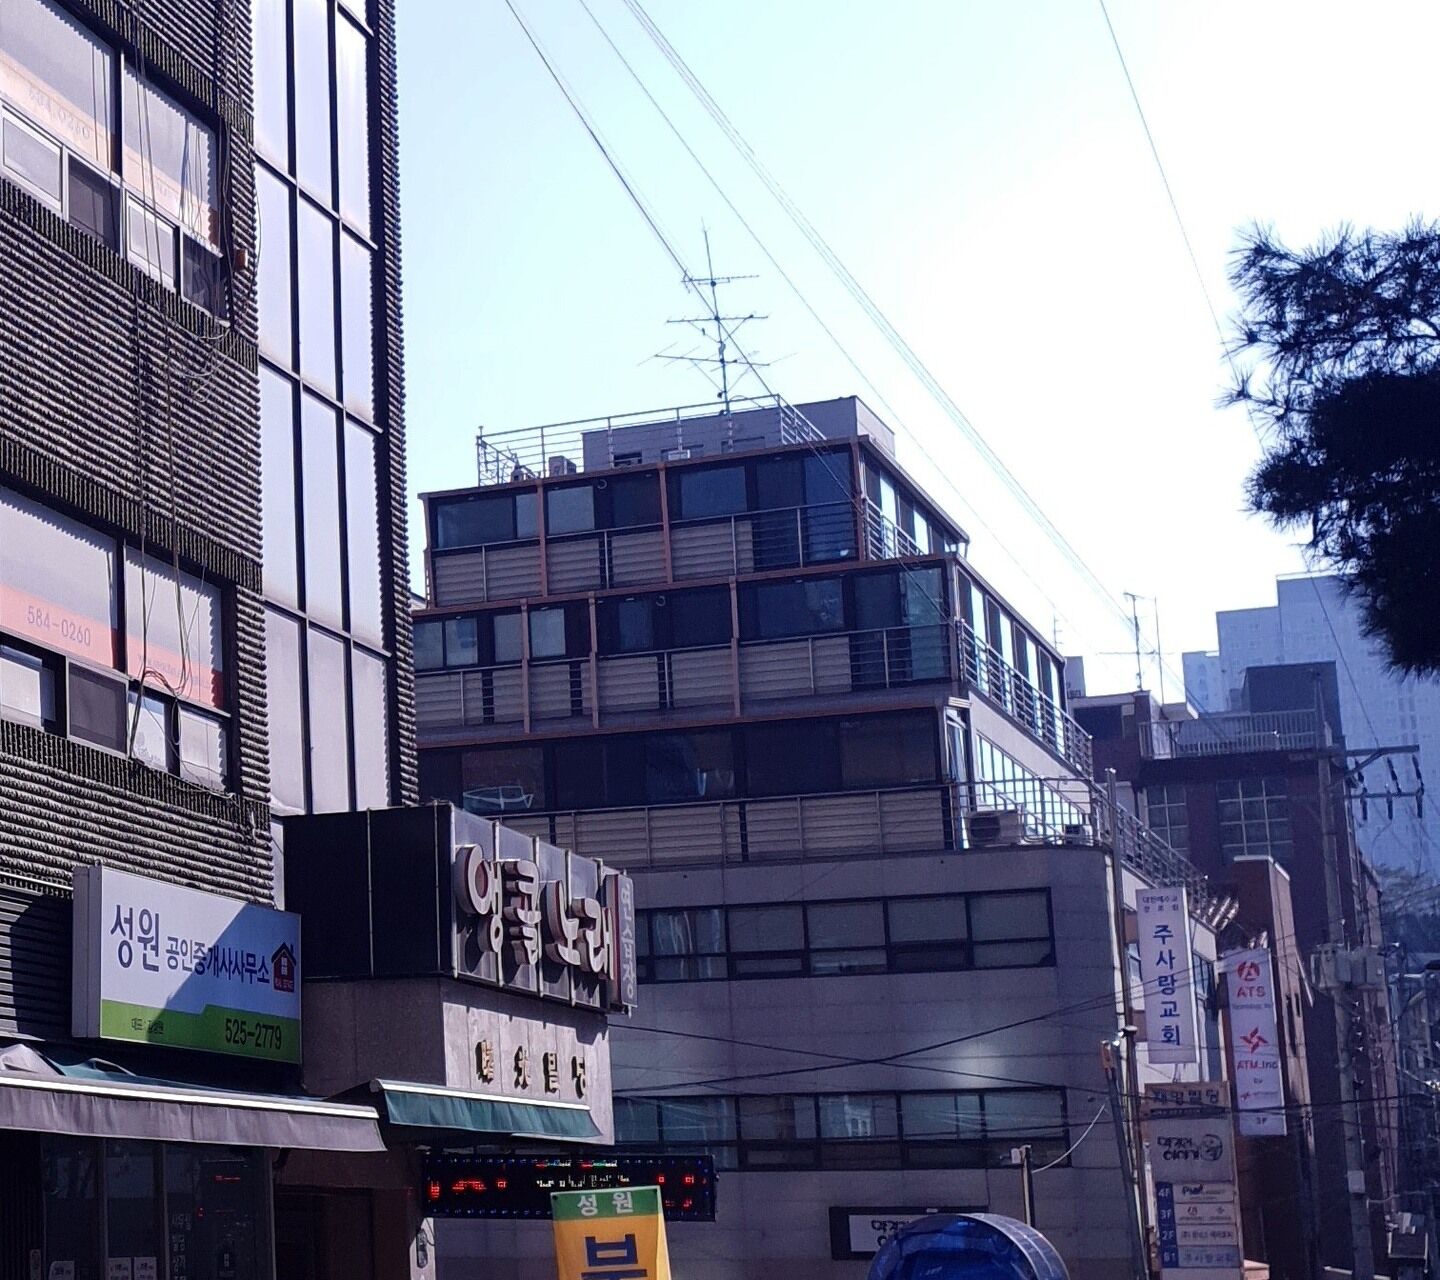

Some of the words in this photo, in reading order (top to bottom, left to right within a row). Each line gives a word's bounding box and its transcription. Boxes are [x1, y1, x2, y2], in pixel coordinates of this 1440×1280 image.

[27, 605, 91, 647] 584-0260
[110, 905, 160, 972] 성원
[165, 935, 270, 984] 공인중개사사무소
[1152, 925, 1181, 1045] 주사랑교회
[1237, 986, 1266, 998] ATS
[225, 1018, 282, 1050] 525-2779
[578, 1192, 633, 1217] 성원
